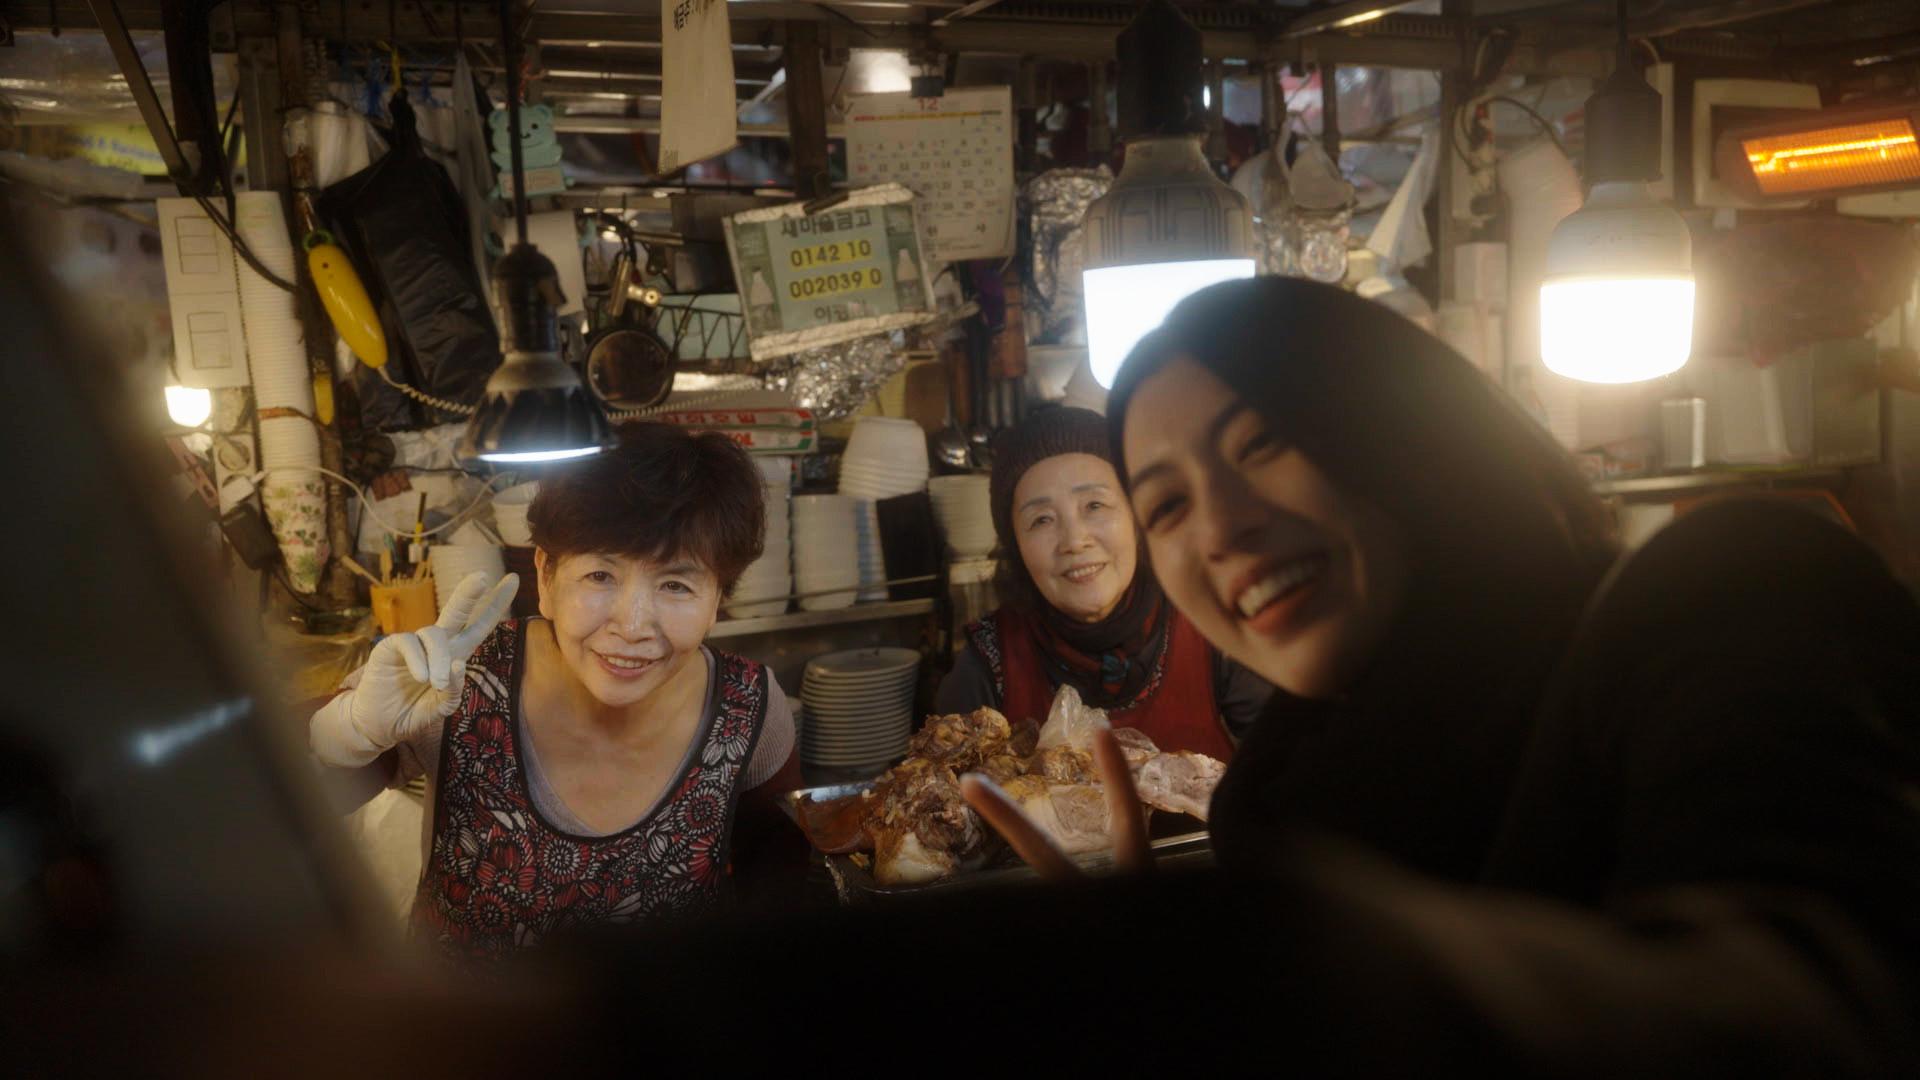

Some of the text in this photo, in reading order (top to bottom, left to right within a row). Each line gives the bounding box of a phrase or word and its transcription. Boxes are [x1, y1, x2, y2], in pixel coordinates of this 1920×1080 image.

[917, 97, 939, 111] 12
[790, 239, 871, 267] 0142 10
[789, 268, 882, 298] 002039 0
